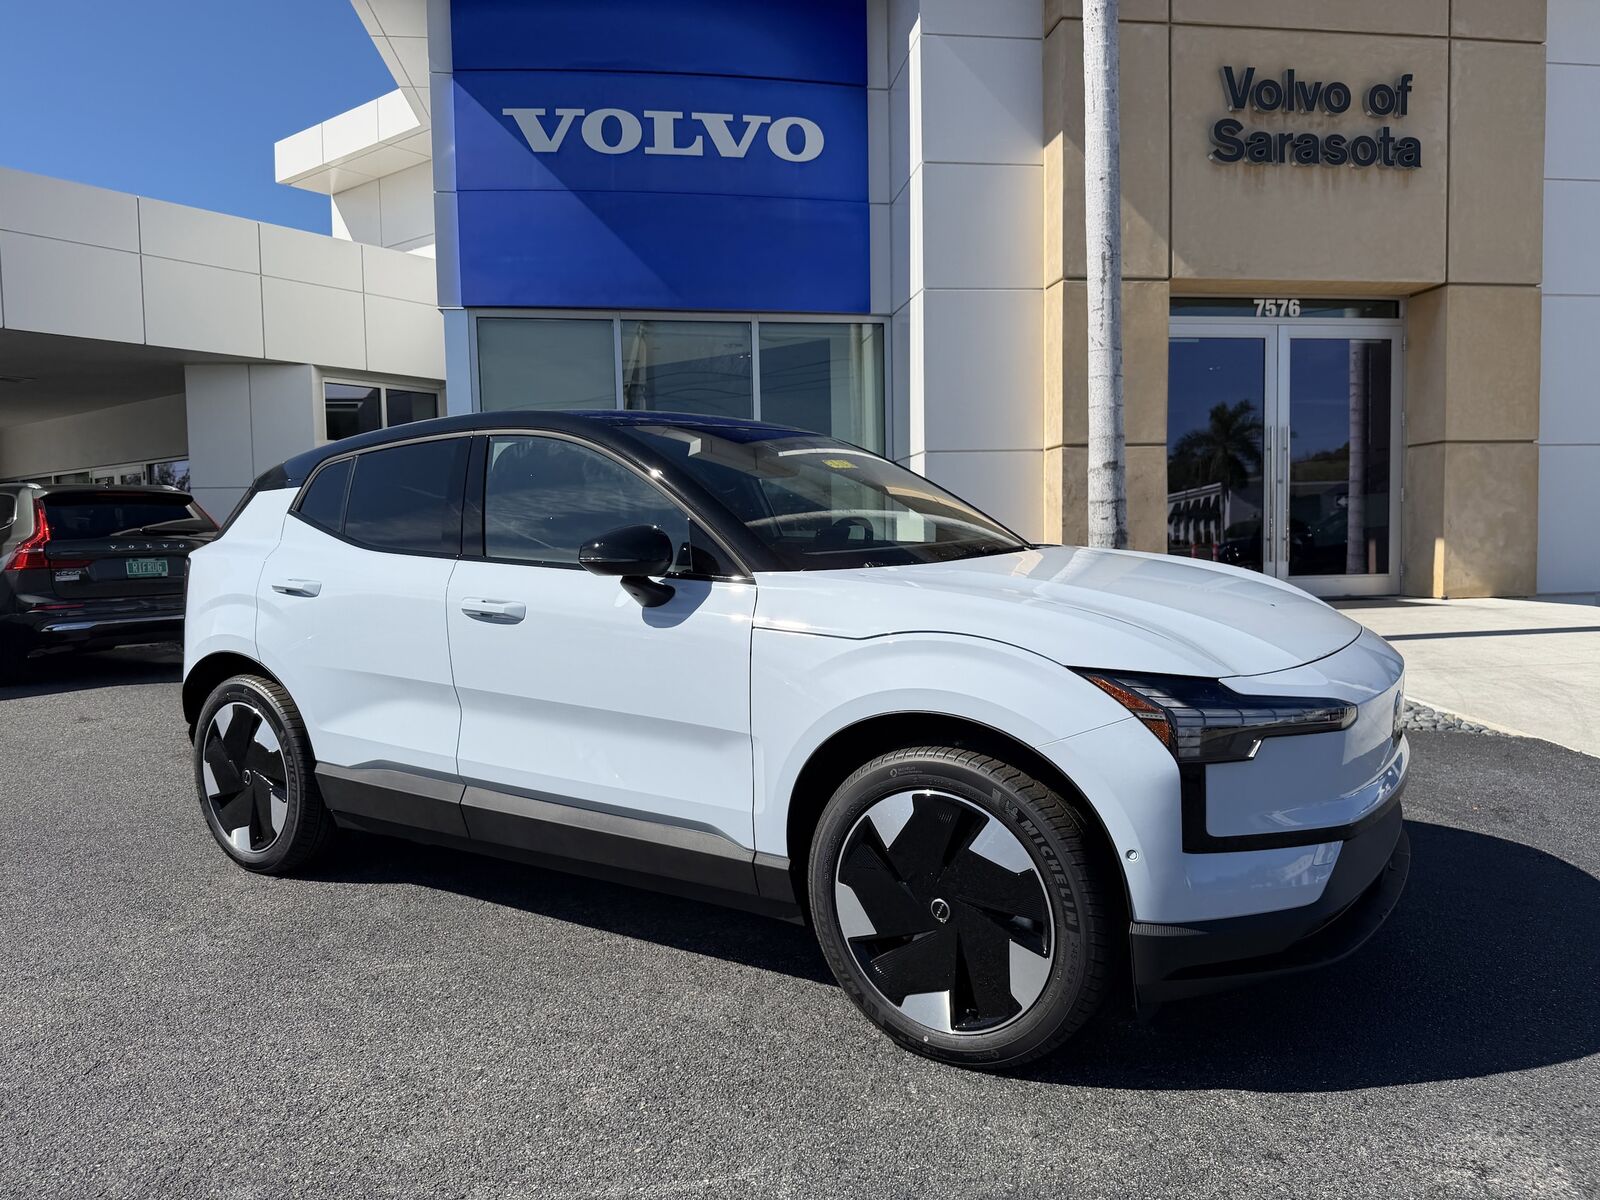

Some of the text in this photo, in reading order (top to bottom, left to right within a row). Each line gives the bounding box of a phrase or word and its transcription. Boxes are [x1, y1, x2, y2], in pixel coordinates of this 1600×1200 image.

[1222, 66, 1413, 116] Volvo of
[502, 107, 824, 162] VOLVO
[1211, 118, 1422, 168] Sarasota
[1253, 299, 1300, 317] 7576
[1020, 820, 1080, 930] MICHELIN
